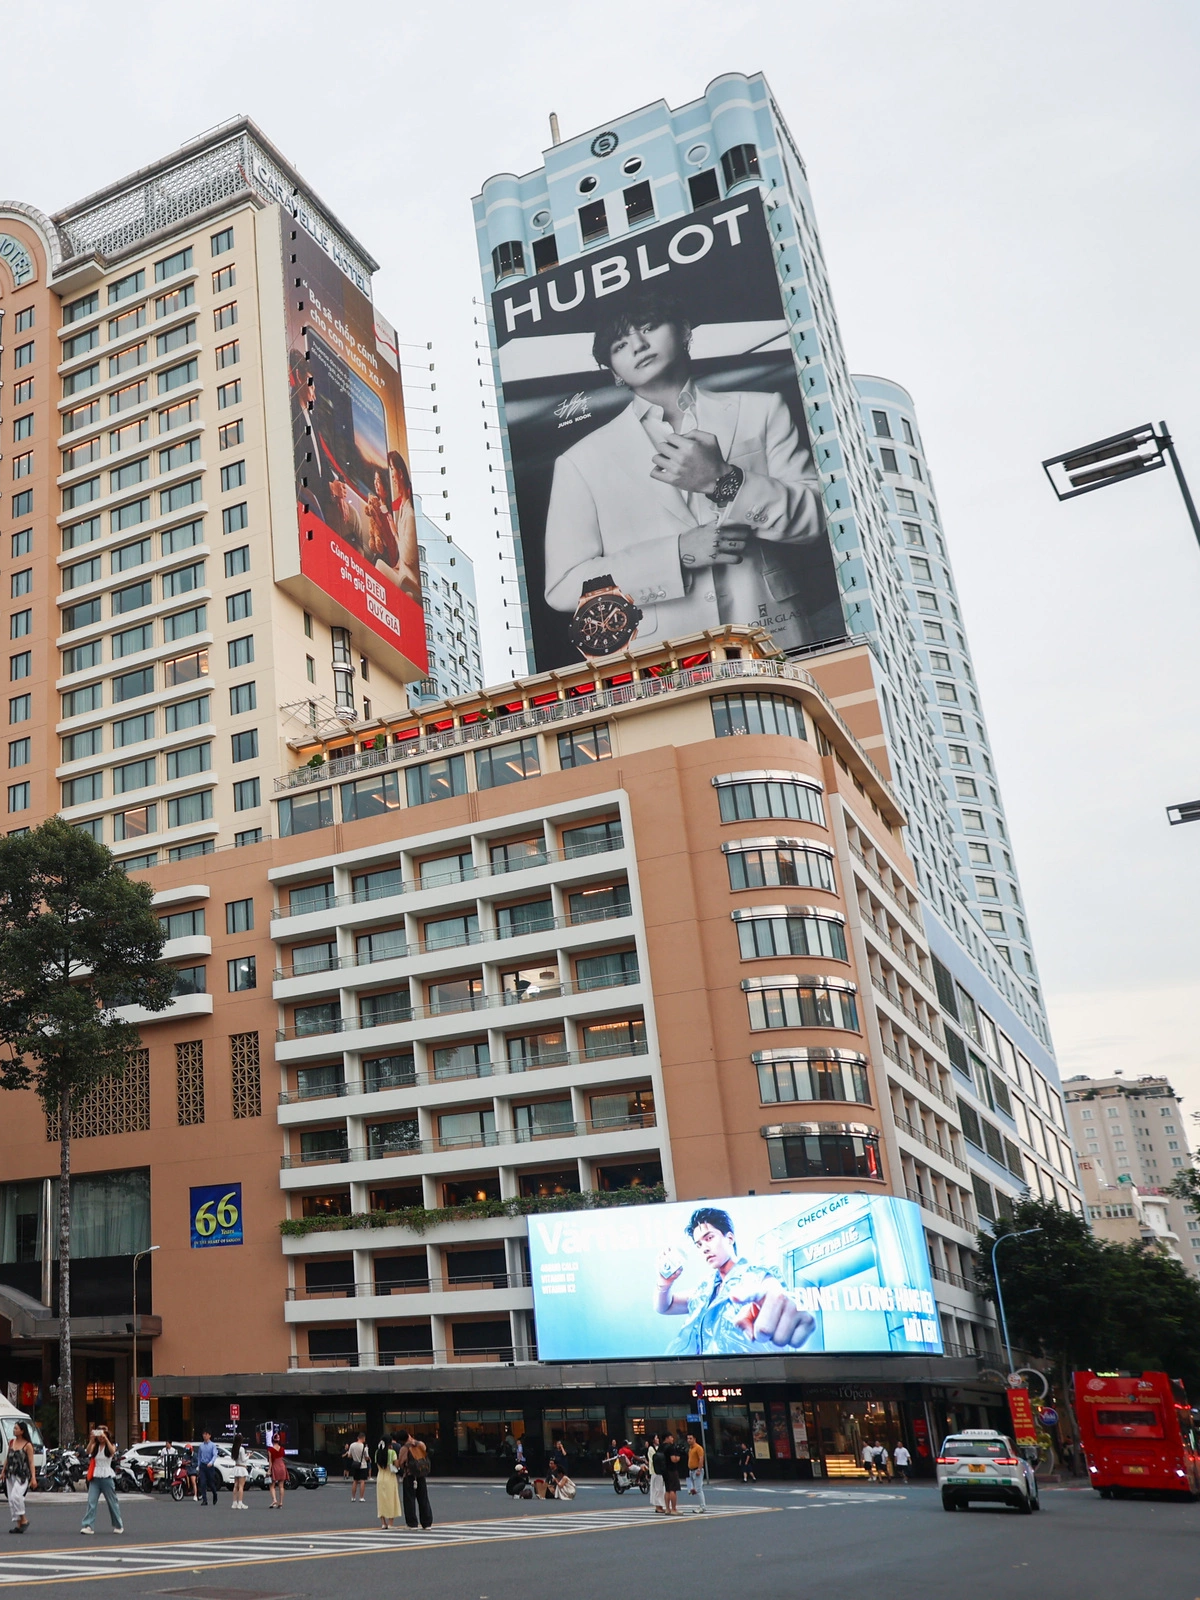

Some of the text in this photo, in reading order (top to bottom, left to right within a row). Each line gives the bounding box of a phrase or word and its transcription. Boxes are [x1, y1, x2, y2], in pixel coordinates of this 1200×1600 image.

[258, 165, 329, 252] CARAVELLE
[333, 245, 369, 297] HOTEL
[503, 203, 749, 333] HUBLOT
[310, 309, 326, 331] cho
[328, 329, 344, 350] con
[345, 345, 367, 374] vươn
[357, 343, 378, 369] cánh
[557, 412, 592, 429] JUNG KOOK
[330, 540, 385, 602] Cùng bạn ĐIỀU
[770, 626, 786, 634] HCMC
[1078, 1162, 1093, 1170] TEL
[195, 1191, 239, 1236] 66
[797, 1195, 849, 1228] CHECK GATE
[722, 1388, 742, 1396] SILK
